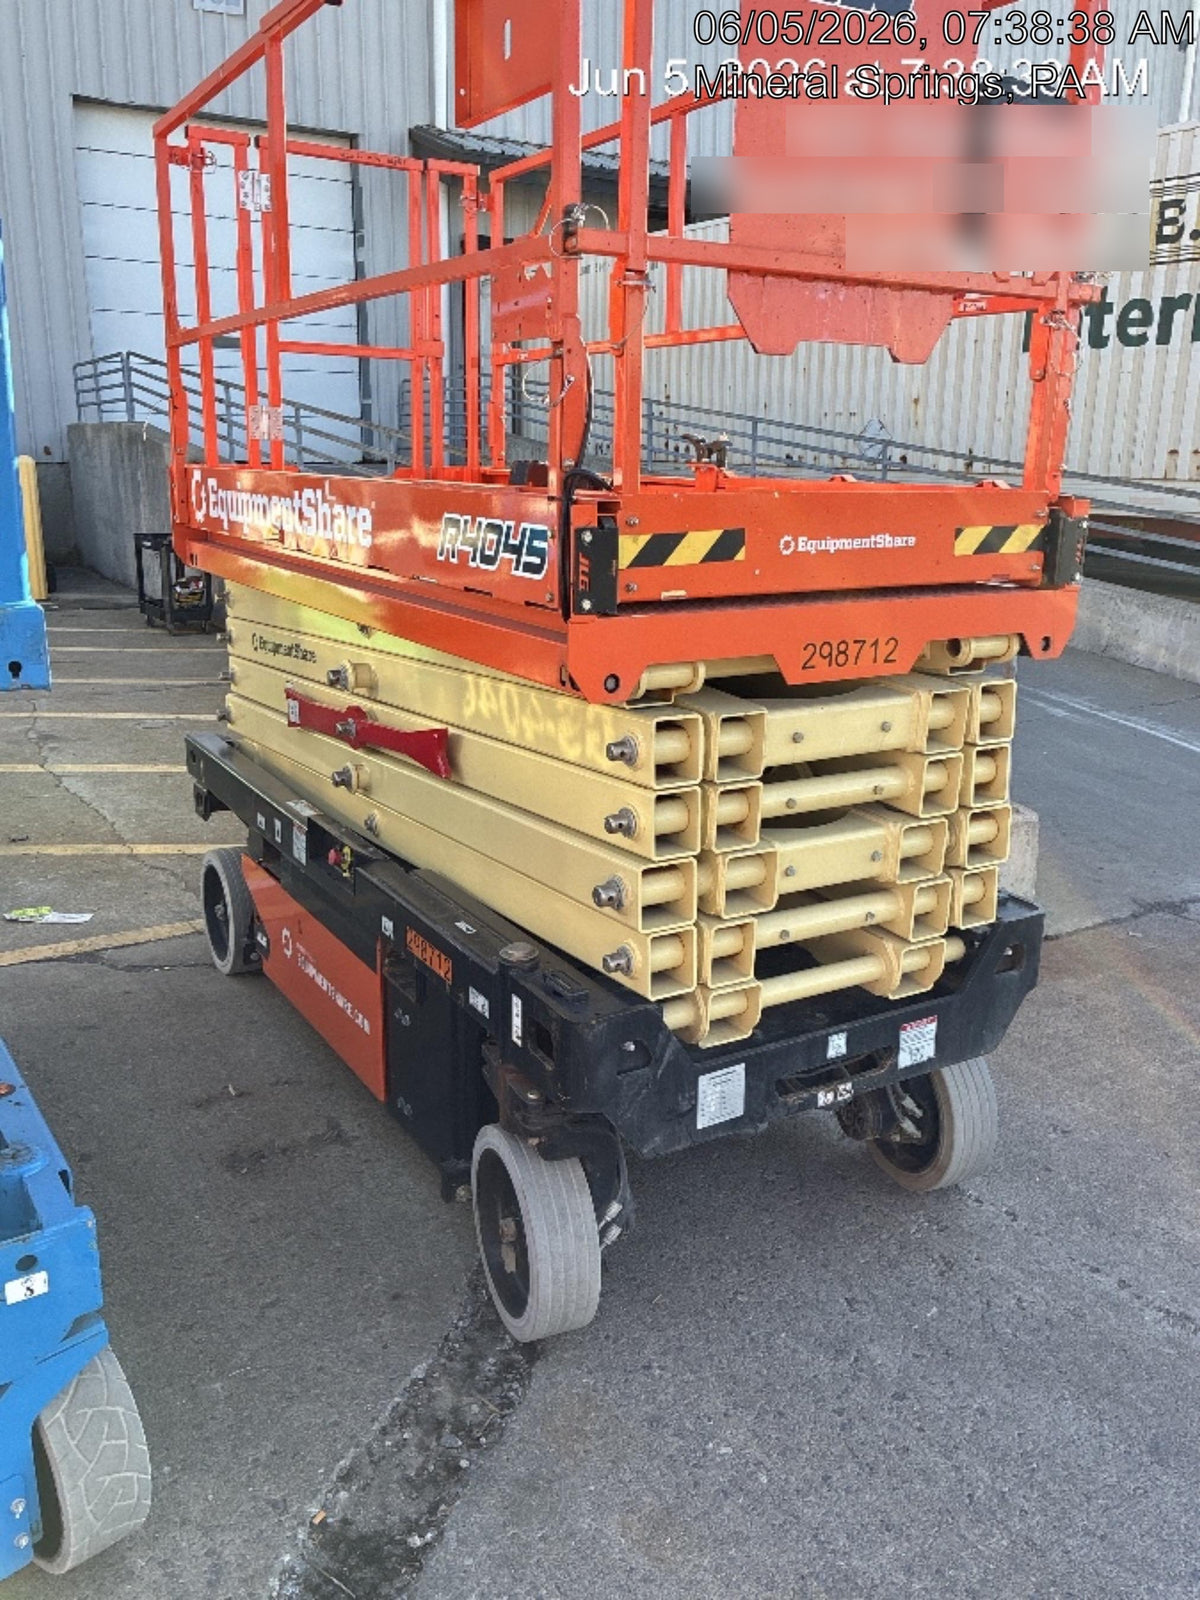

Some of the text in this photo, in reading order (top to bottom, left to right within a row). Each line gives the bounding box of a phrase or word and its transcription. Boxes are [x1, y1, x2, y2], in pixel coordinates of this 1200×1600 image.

[207, 477, 373, 548] EquipmentShare
[437, 511, 549, 580] R4045
[797, 533, 917, 554] EquipmentShare
[801, 637, 900, 671] 298712
[408, 930, 451, 981] 298712
